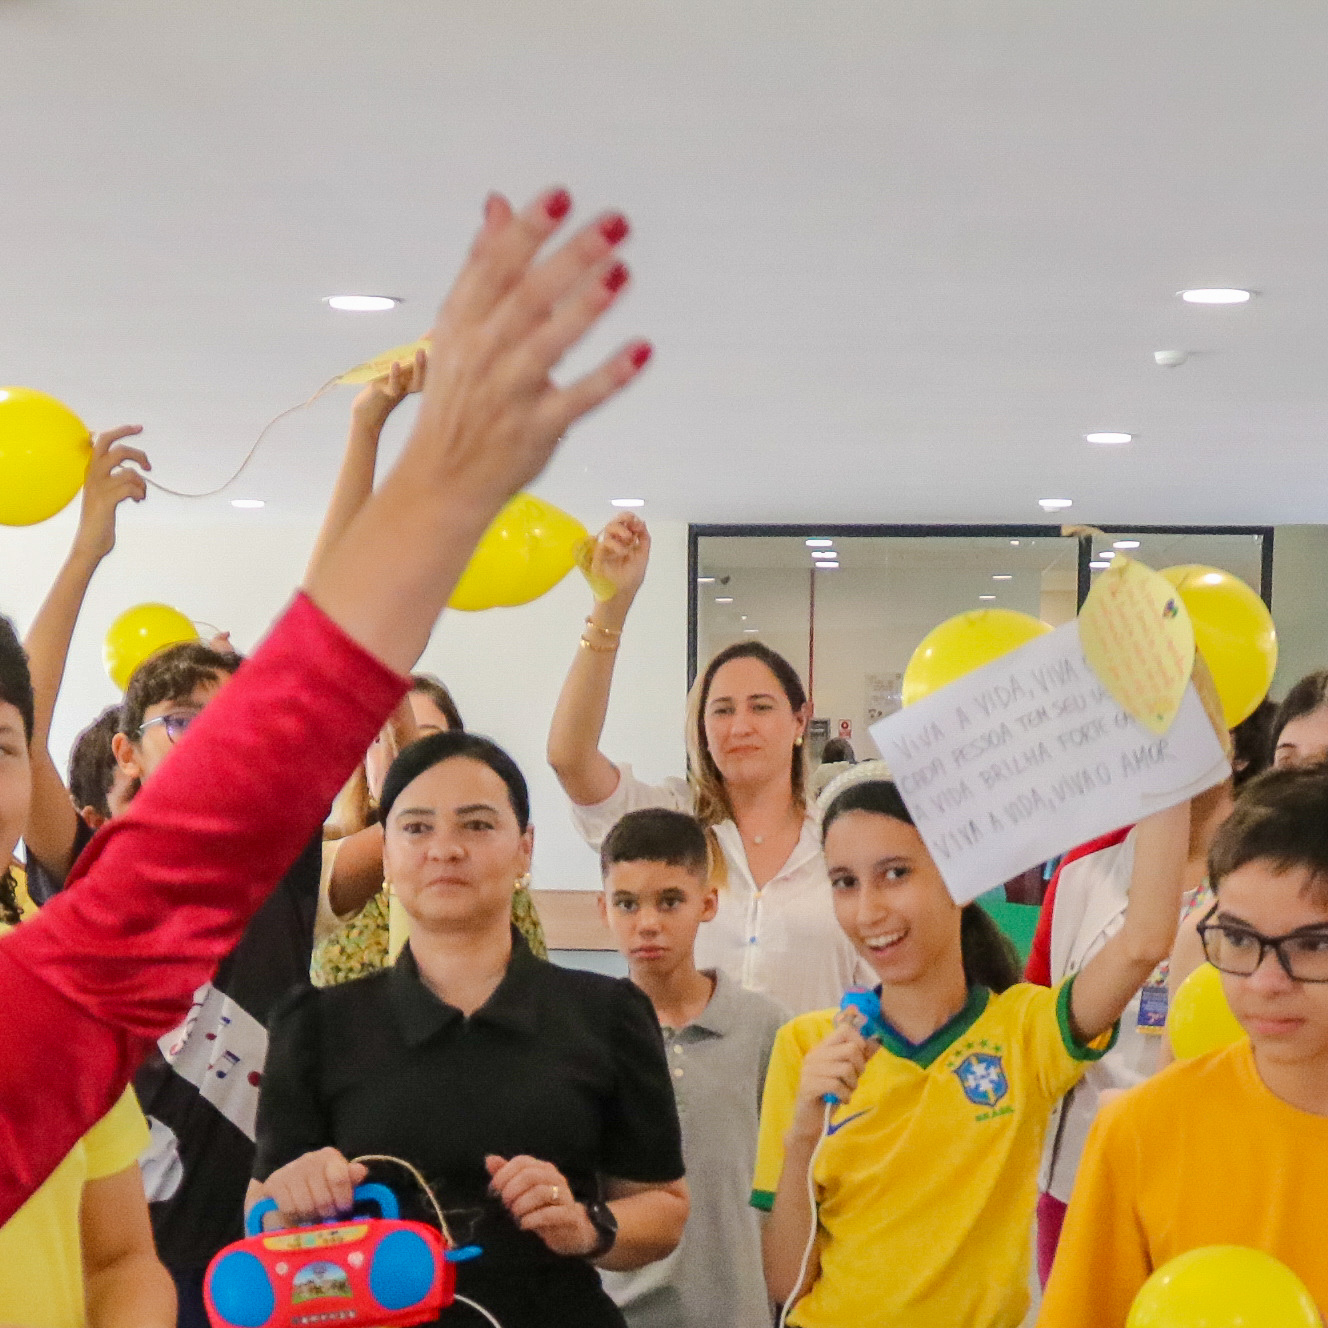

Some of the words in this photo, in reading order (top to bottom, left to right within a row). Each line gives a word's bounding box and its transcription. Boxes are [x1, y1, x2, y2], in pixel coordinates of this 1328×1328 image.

[892, 721, 945, 760] VIVA
[955, 705, 972, 730] A
[1031, 657, 1079, 693] VIVA
[951, 722, 1013, 769] PESSOA
[1014, 705, 1051, 732] TEM
[1051, 694, 1087, 718] SEU
[929, 777, 974, 814] VIDA
[978, 741, 1053, 790] BRILHA
[1057, 716, 1110, 752] FORTE
[933, 818, 984, 859] VIVA
[987, 811, 1005, 833] A
[1121, 738, 1176, 778] AMOR
